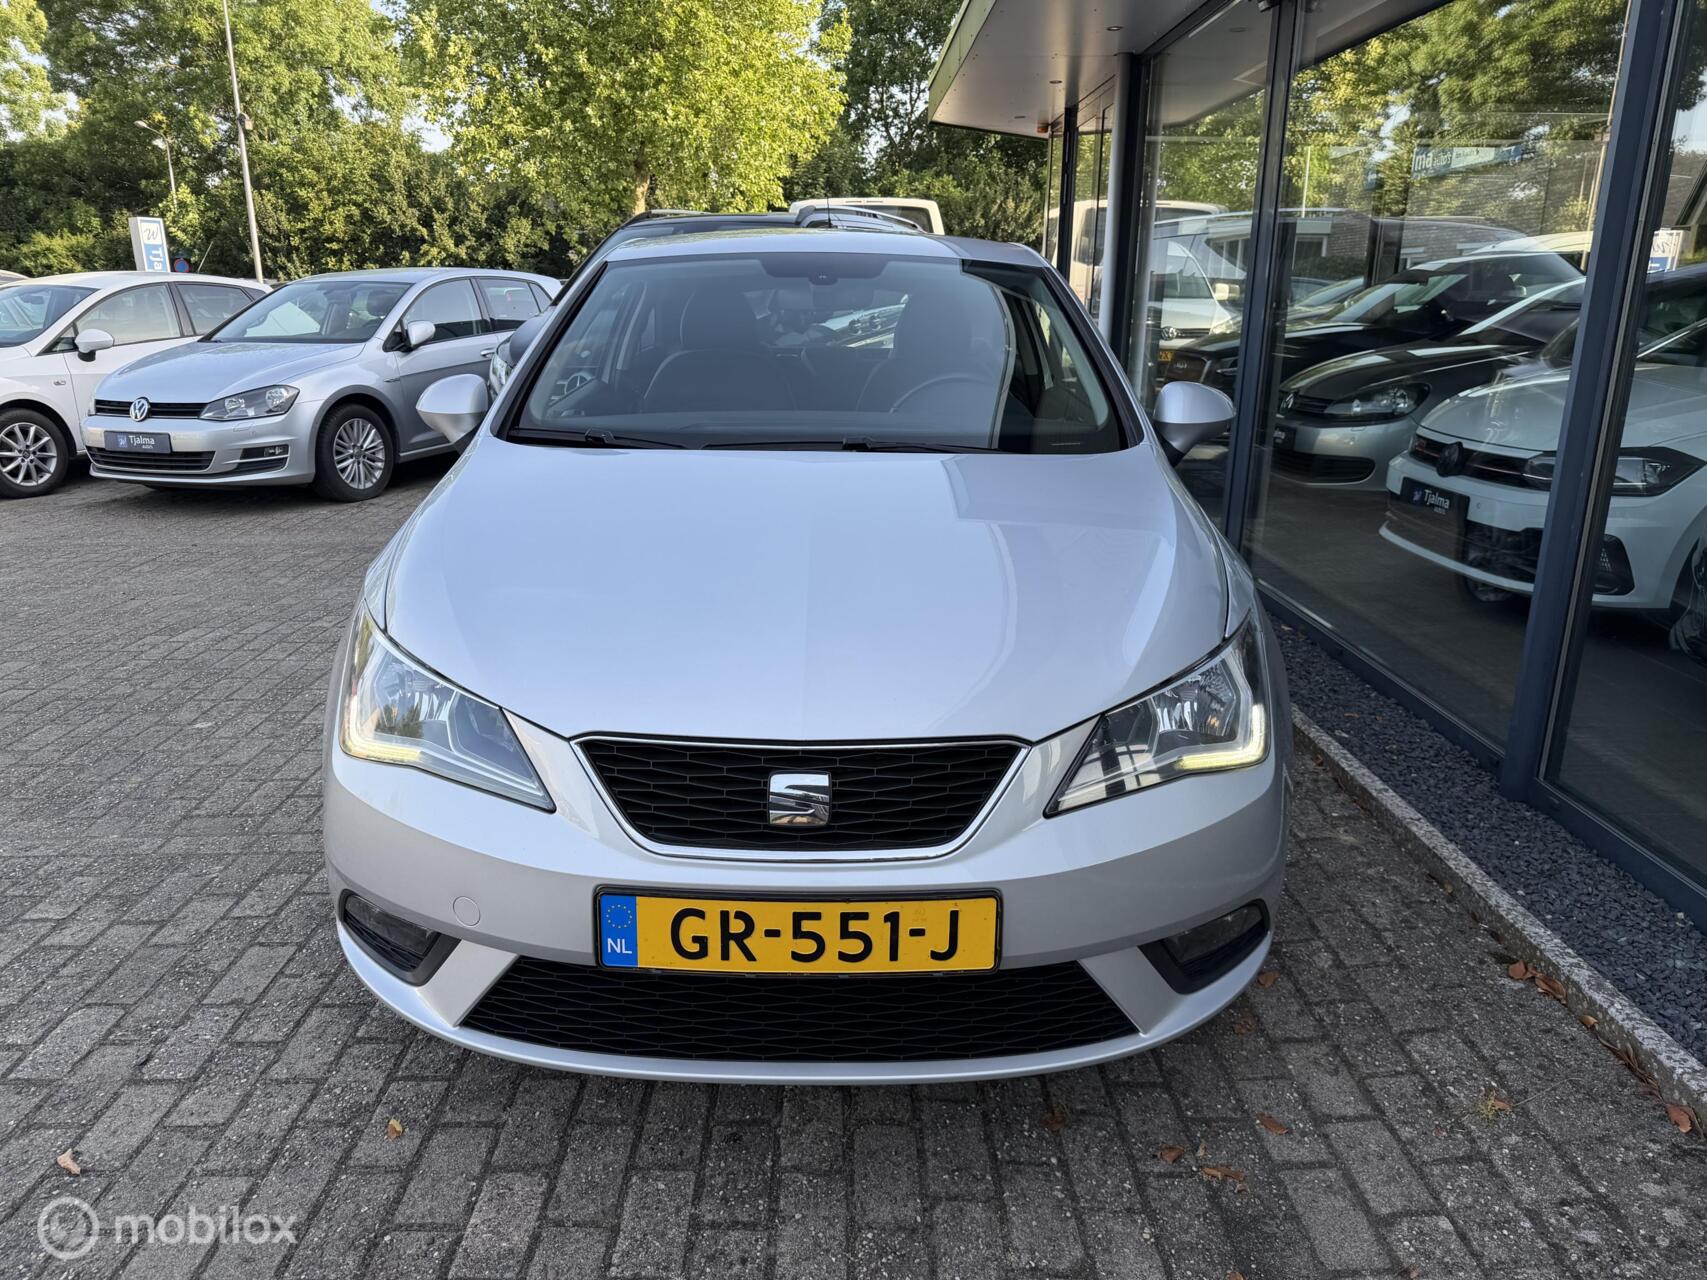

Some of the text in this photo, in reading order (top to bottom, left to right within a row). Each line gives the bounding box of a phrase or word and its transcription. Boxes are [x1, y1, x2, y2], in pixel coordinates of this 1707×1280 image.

[128, 435, 155, 446] Tjalma
[1424, 489, 1450, 509] Tjalma
[670, 907, 960, 962] GR-551-J
[607, 937, 632, 954] NL
